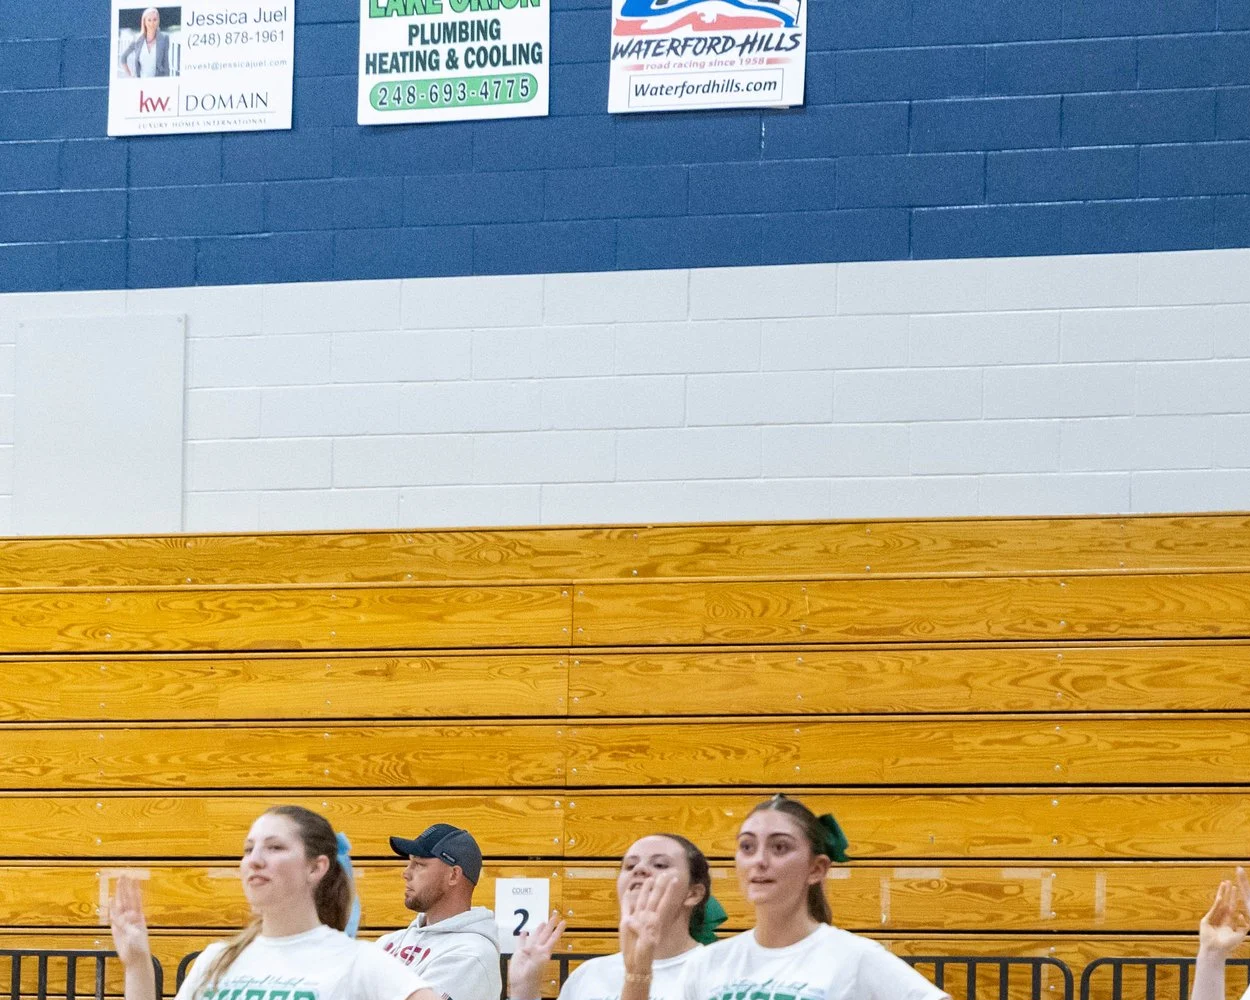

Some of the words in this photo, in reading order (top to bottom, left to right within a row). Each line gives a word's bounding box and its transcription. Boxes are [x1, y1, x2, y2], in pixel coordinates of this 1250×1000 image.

[186, 9, 248, 27] Jessica
[254, 6, 287, 24] Juel
[187, 33, 221, 50] (248)
[224, 30, 285, 44] 878-1961
[408, 18, 501, 46] PLUMBING
[612, 35, 736, 61] WATERFORD
[736, 31, 802, 57] HILLS
[365, 49, 440, 75] HEATING
[445, 48, 459, 70] &
[464, 42, 543, 69] COOLING
[646, 59, 671, 70] road
[672, 59, 706, 71] racing
[709, 57, 736, 67] since
[739, 57, 765, 66] 1958
[378, 78, 529, 107] 248-693-4775
[634, 79, 778, 99] Waterfordhills.com
[139, 90, 169, 113] kw
[185, 91, 269, 112] DOMAIN
[512, 887, 532, 895] COURT
[513, 908, 530, 937] 2
